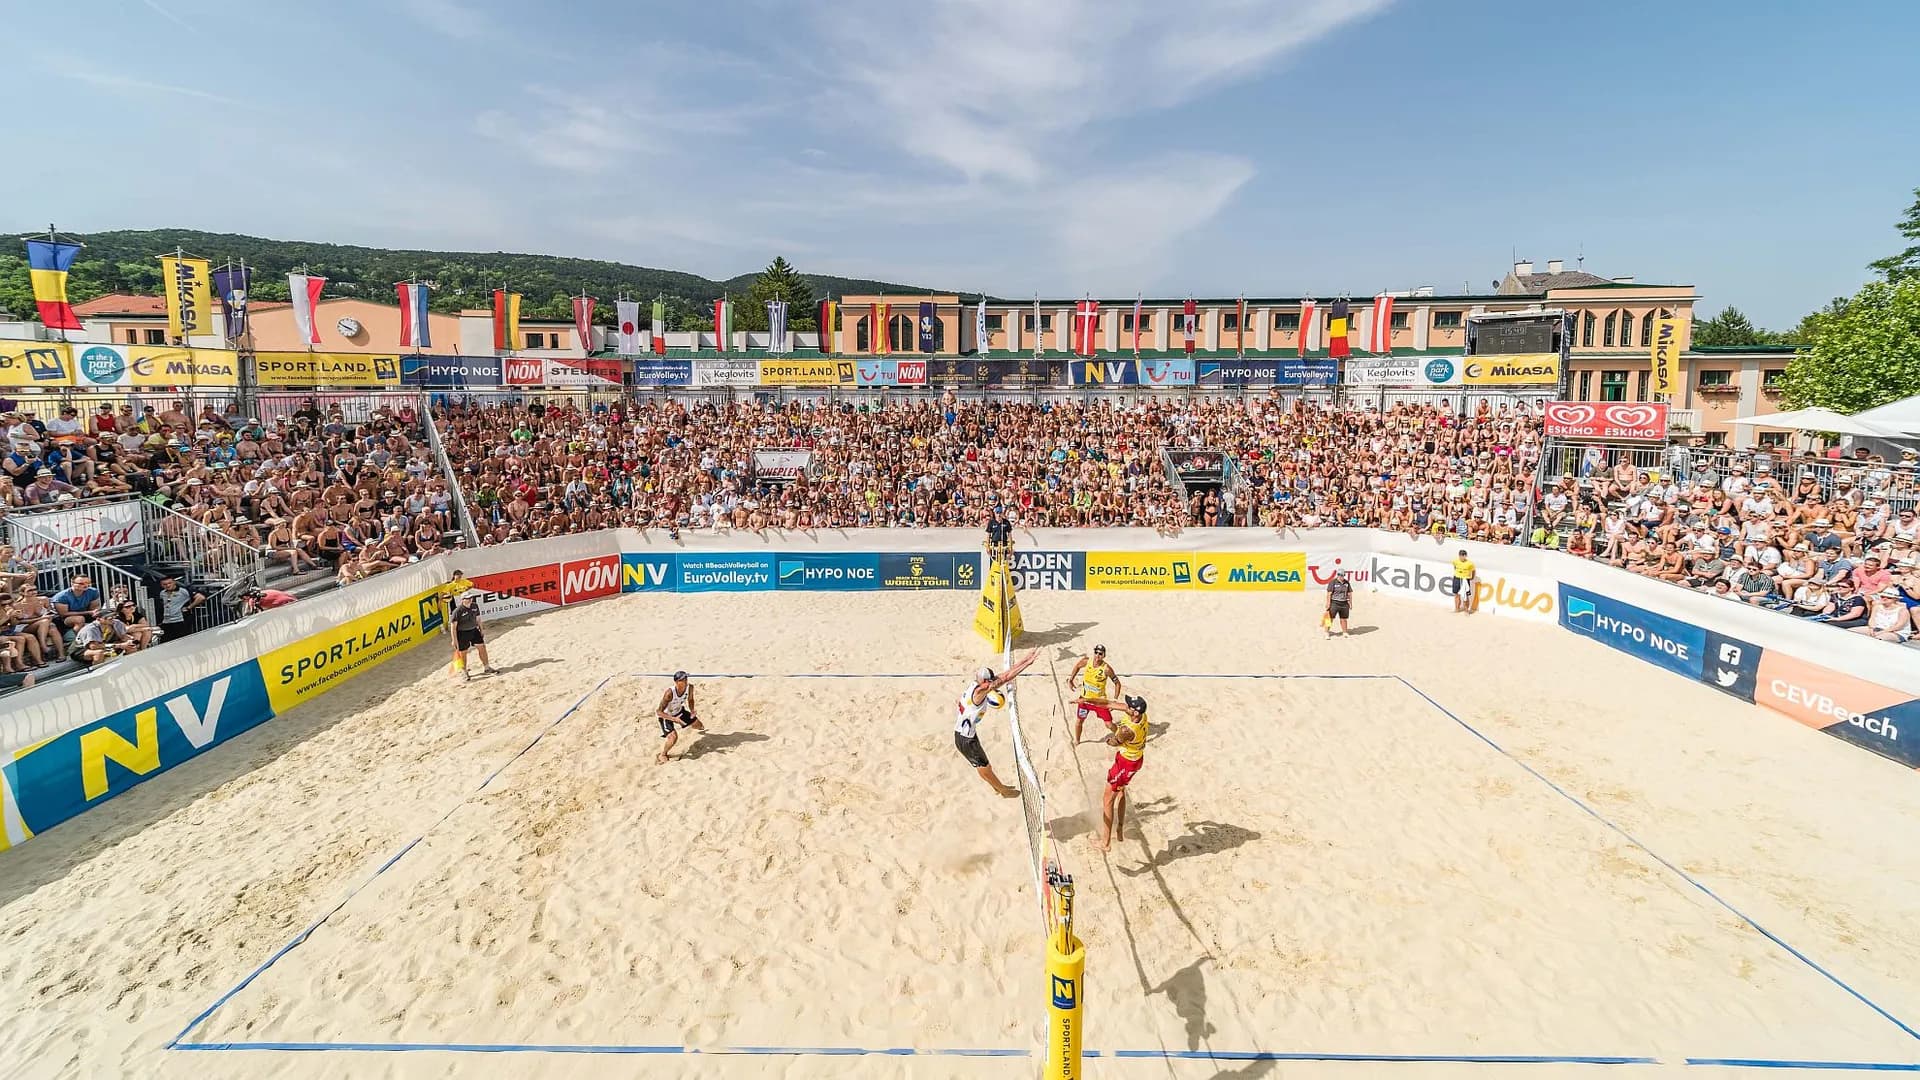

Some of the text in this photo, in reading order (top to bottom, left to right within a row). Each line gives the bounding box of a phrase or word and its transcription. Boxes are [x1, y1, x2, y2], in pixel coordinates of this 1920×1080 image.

[88, 356, 117, 373] park
[259, 361, 371, 372] SPORT.LAND.
[431, 366, 500, 376] HYPO NOE
[508, 361, 540, 380] NÖN
[1429, 364, 1449, 376] park
[551, 368, 618, 376] STEURER
[639, 371, 689, 380] EuroVolley.tv
[714, 369, 754, 379] Keglovits
[763, 368, 836, 376] SPORT.LAND.
[881, 372, 896, 380] TUI
[899, 365, 925, 379] NÖN
[1085, 362, 1126, 383] NV
[1173, 371, 1191, 380] TUI
[1221, 369, 1276, 378] HYPO NOE
[1284, 370, 1334, 380] EuroVolley.tv
[1367, 368, 1416, 378] Keglovits
[1548, 425, 1594, 435] ESKIMO
[1605, 427, 1656, 438] ESKIMO
[1008, 553, 1072, 569] BADEN
[623, 563, 668, 585] NV
[805, 568, 874, 578] HYPO NOE
[1089, 566, 1170, 576] SPORT.LAND.
[1345, 570, 1369, 582] TUI
[1371, 556, 1456, 597] kabe
[565, 560, 619, 596] NÖN
[684, 571, 768, 586] EuroVolley.tv
[1011, 571, 1072, 590] OPEN
[1100, 578, 1165, 586] www.sportlandnoe.at
[470, 580, 557, 603] TEURER
[1474, 577, 1553, 613] plus
[1596, 614, 1689, 660] HYPO NOE
[281, 614, 415, 685] SPORT.LAND.
[296, 637, 412, 695] www.facebook.com/sportlandnoe
[1771, 679, 1898, 740] CEVBeach
[80, 676, 231, 802] NV
[1062, 1018, 1071, 1078] SPORT.LAND.
